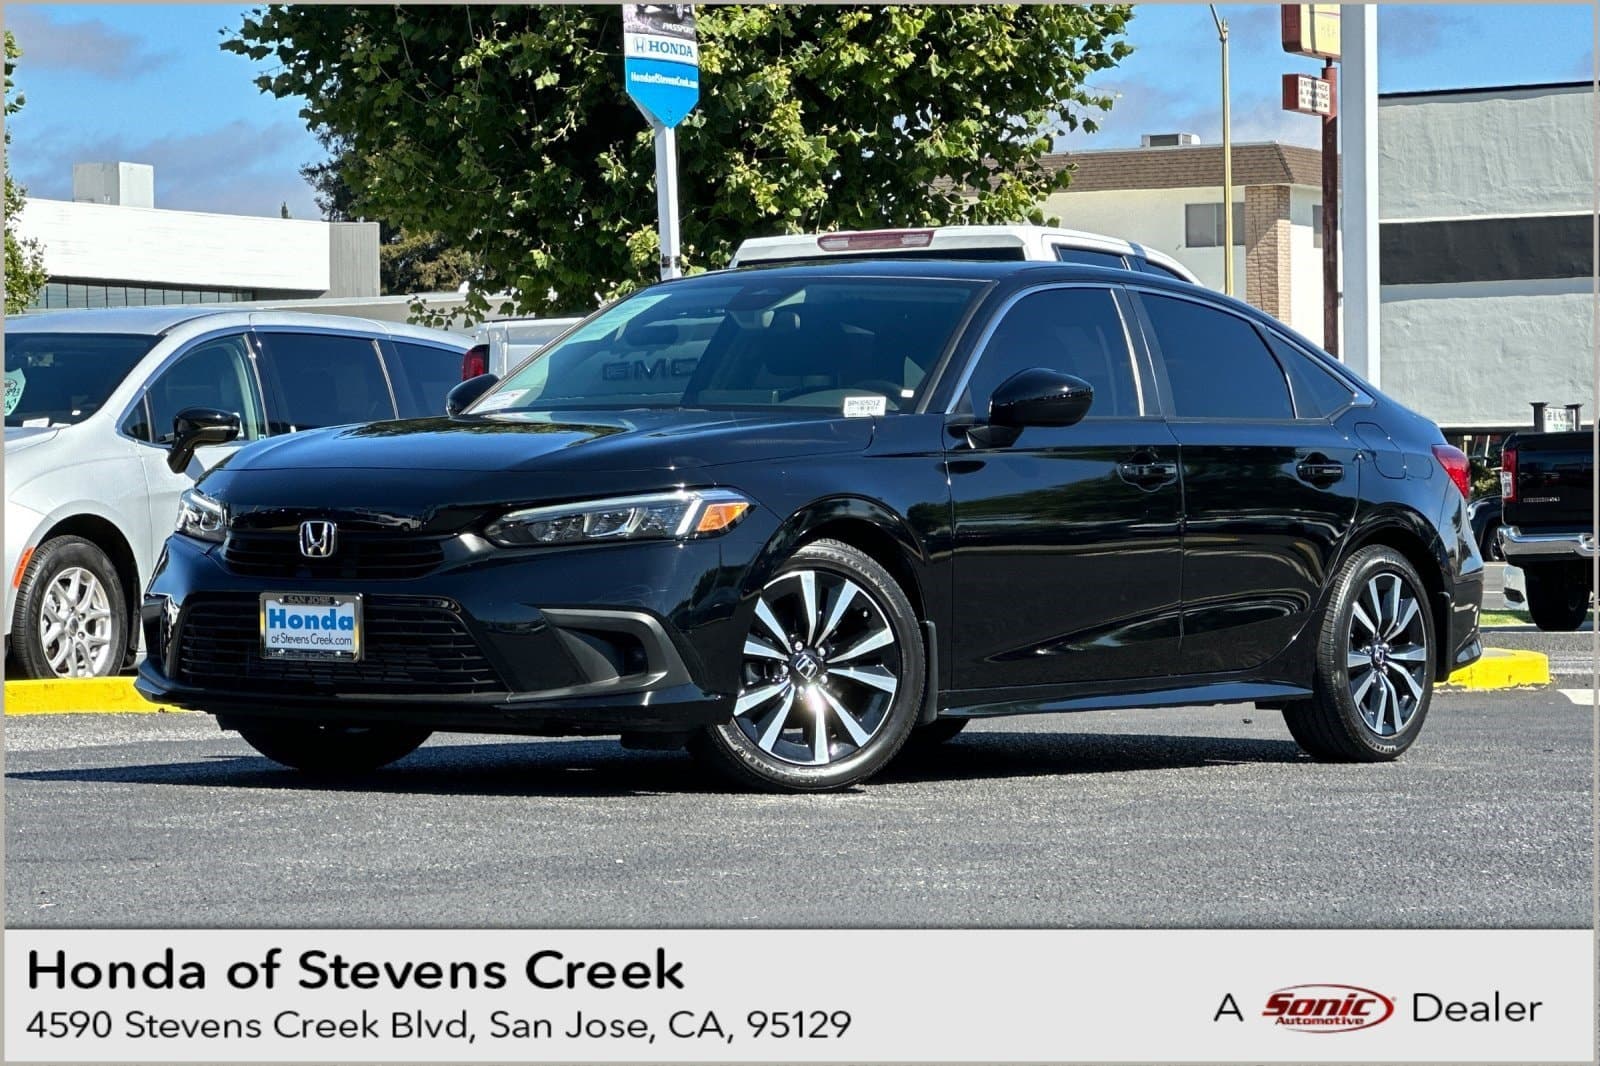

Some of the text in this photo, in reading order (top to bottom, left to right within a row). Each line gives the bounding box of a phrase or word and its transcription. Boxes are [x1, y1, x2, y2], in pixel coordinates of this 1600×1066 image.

[648, 40, 694, 57] HONDA
[602, 358, 699, 381] GMC
[268, 608, 354, 631] Honda
[271, 634, 280, 644] of
[280, 632, 310, 645] Stevens
